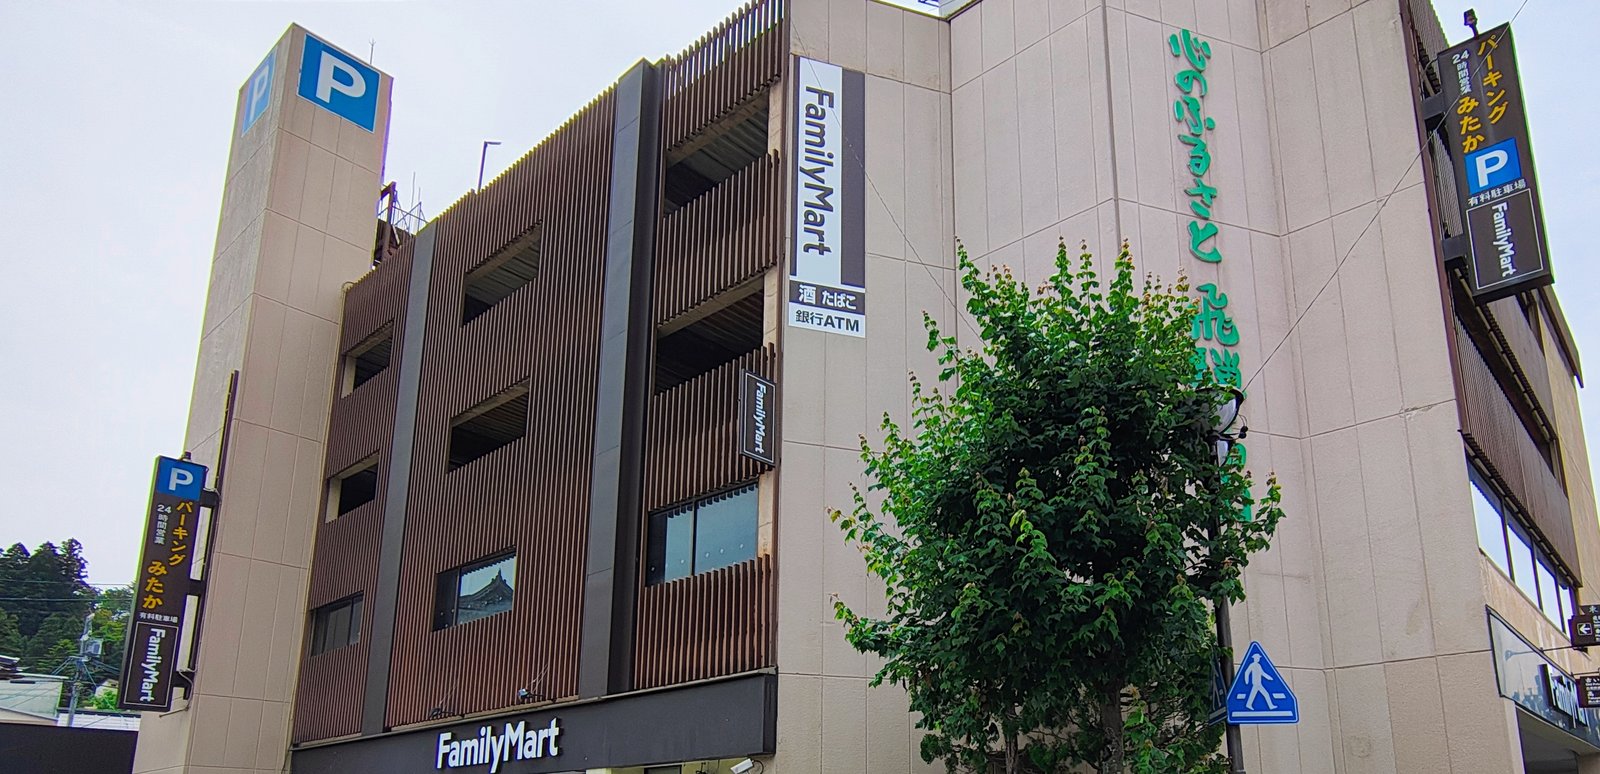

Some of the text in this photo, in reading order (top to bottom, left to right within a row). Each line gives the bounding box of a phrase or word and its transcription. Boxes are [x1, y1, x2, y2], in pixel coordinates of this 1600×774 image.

[250, 64, 270, 122] P
[315, 50, 366, 104] P
[1477, 34, 1508, 124] パーキング
[1168, 29, 1222, 263] 心のふるさと
[1457, 96, 1485, 153] みたか
[799, 86, 834, 256] FamilyMart
[1468, 178, 1527, 207] 有料駐車場
[1475, 149, 1508, 188] P
[1491, 202, 1518, 278] FamilyMart
[795, 309, 860, 332] 銀行ATM
[798, 284, 857, 310] 酒 たばこ
[753, 382, 766, 454] FamilyMart
[168, 467, 194, 491] P
[168, 501, 193, 567] パーキング
[142, 560, 168, 610] みたか
[140, 627, 166, 702] FamilyMart
[436, 717, 560, 774] FamilyMart
